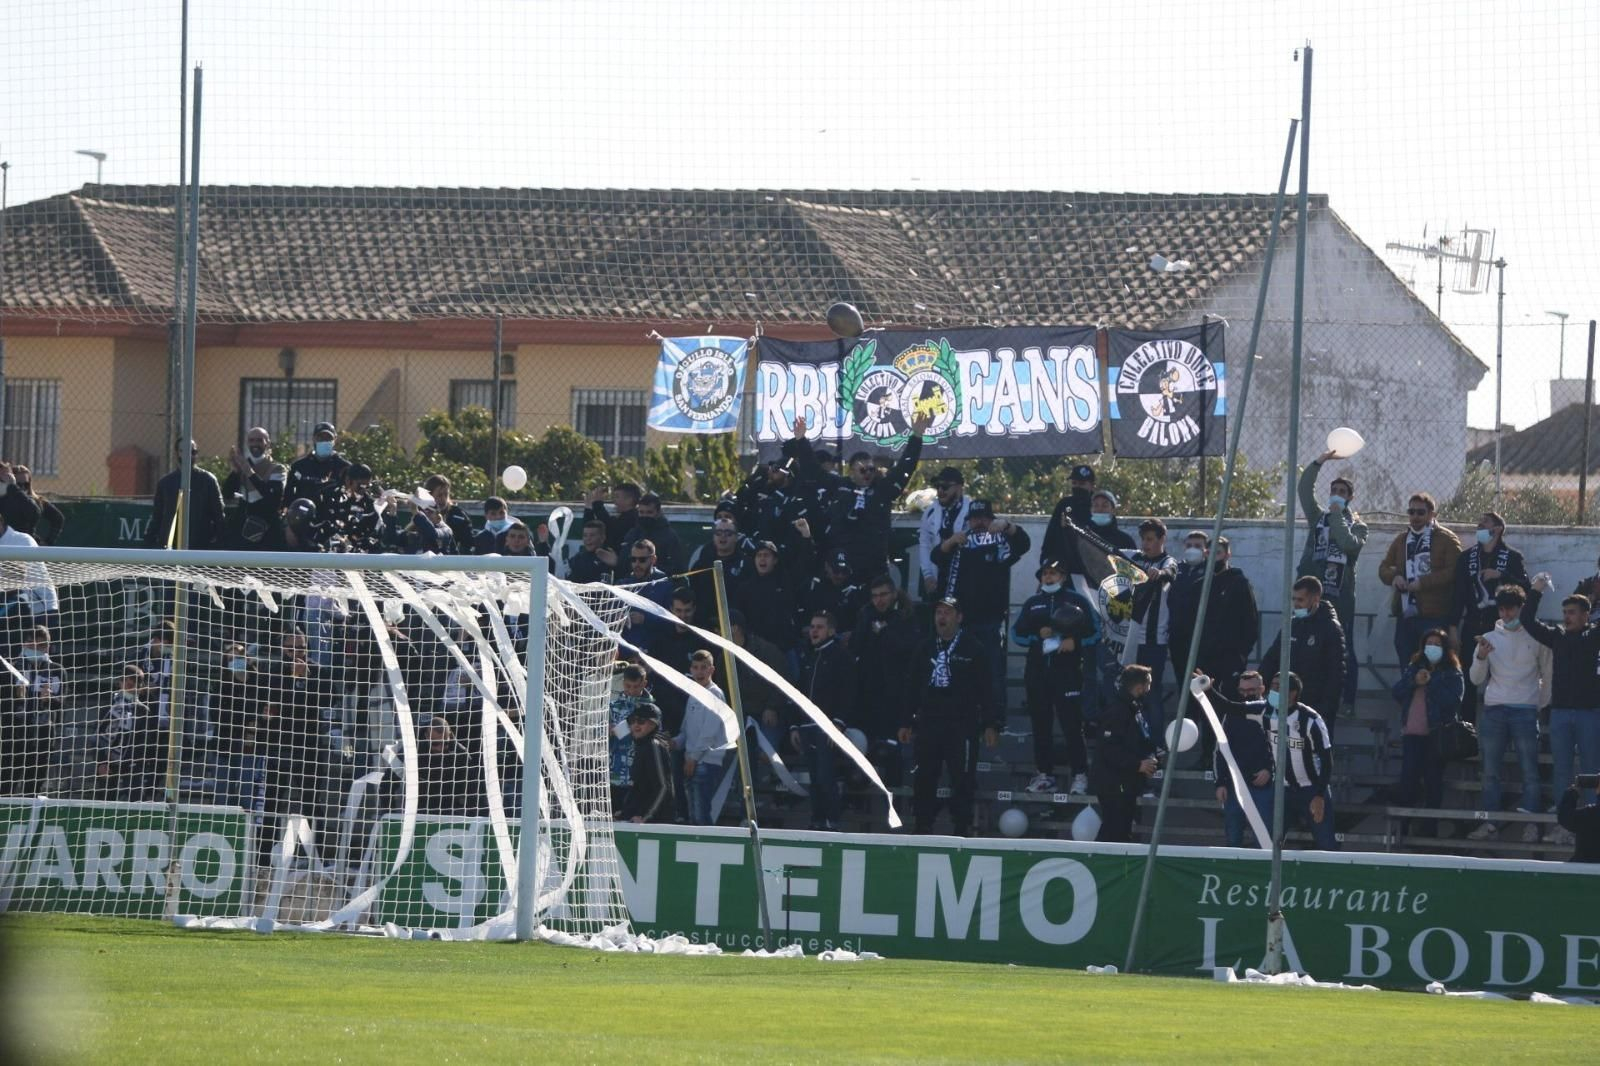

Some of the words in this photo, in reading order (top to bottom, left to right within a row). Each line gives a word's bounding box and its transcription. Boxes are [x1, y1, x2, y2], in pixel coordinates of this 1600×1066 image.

[1118, 340, 1183, 390] COLECTIVO
[1183, 346, 1216, 388] DOCE
[675, 393, 688, 413] SAN
[687, 395, 733, 420] FERNANDO
[758, 360, 854, 442] RBL
[956, 345, 1099, 437] FANS
[857, 373, 899, 399] COLECTIVO
[1136, 414, 1201, 446] BALONA
[1197, 874, 1429, 915] Restaurante
[1343, 922, 1600, 991] BODE
